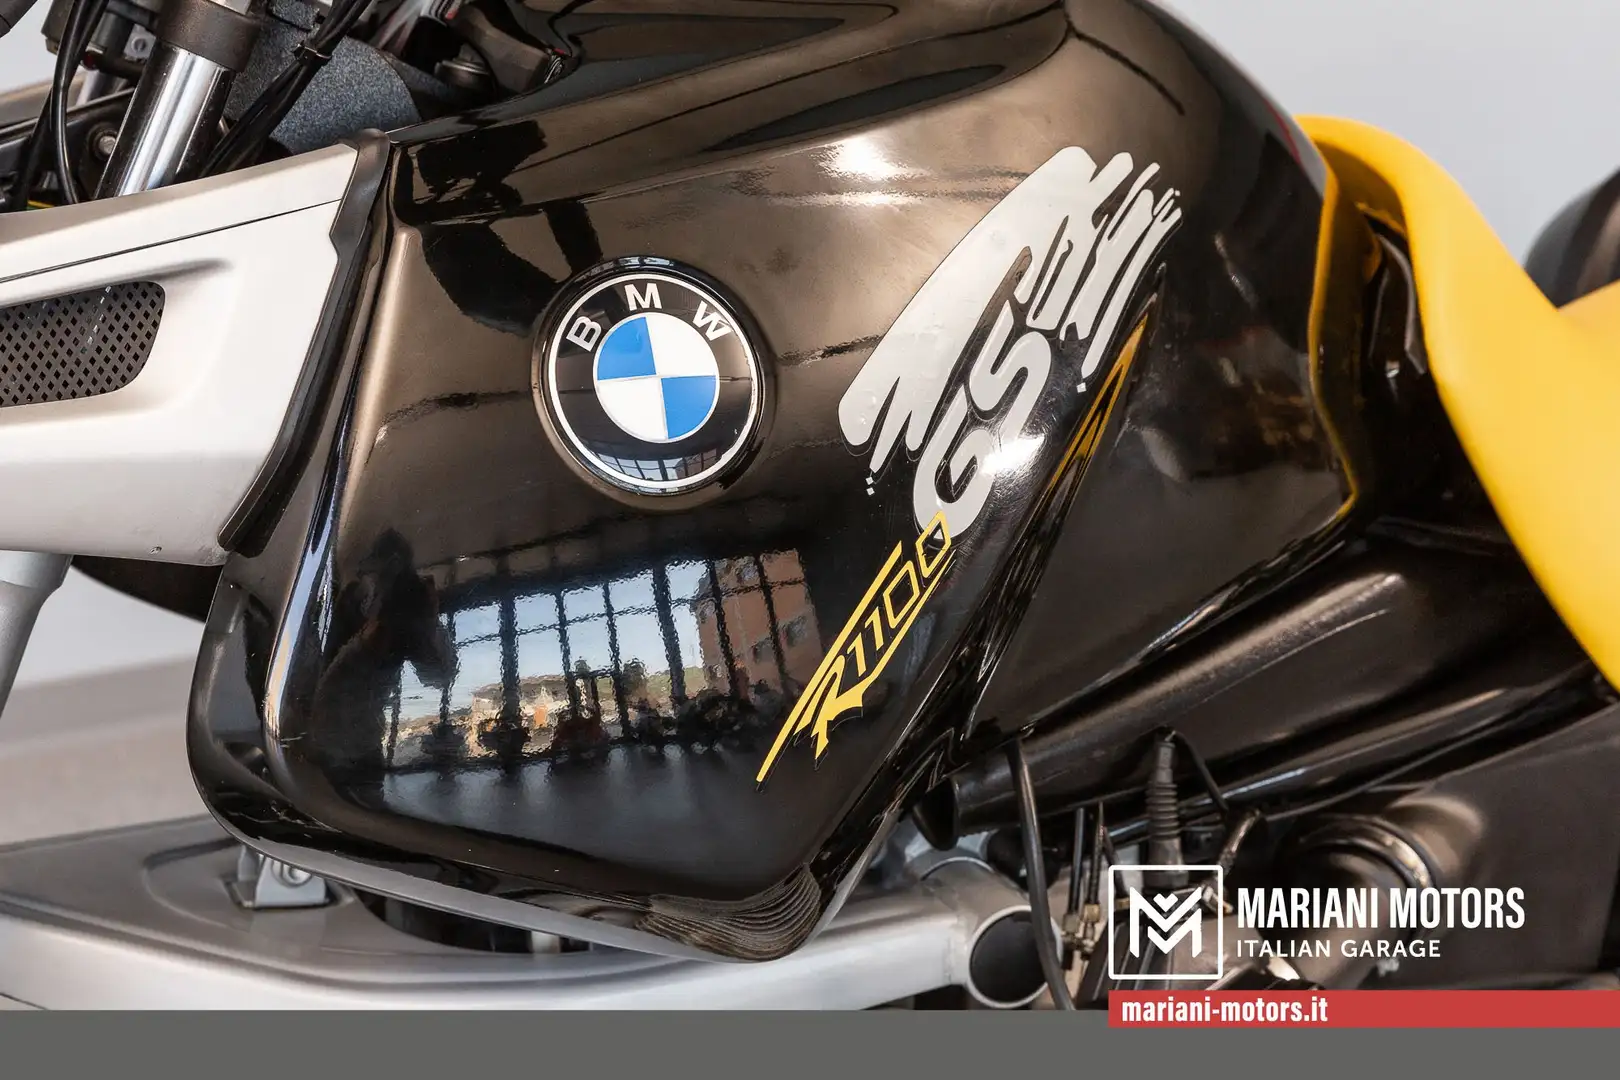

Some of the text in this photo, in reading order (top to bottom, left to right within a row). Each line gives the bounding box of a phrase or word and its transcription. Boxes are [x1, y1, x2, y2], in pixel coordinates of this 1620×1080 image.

[566, 282, 732, 352] BMW
[776, 300, 1052, 770] R1100 GS
